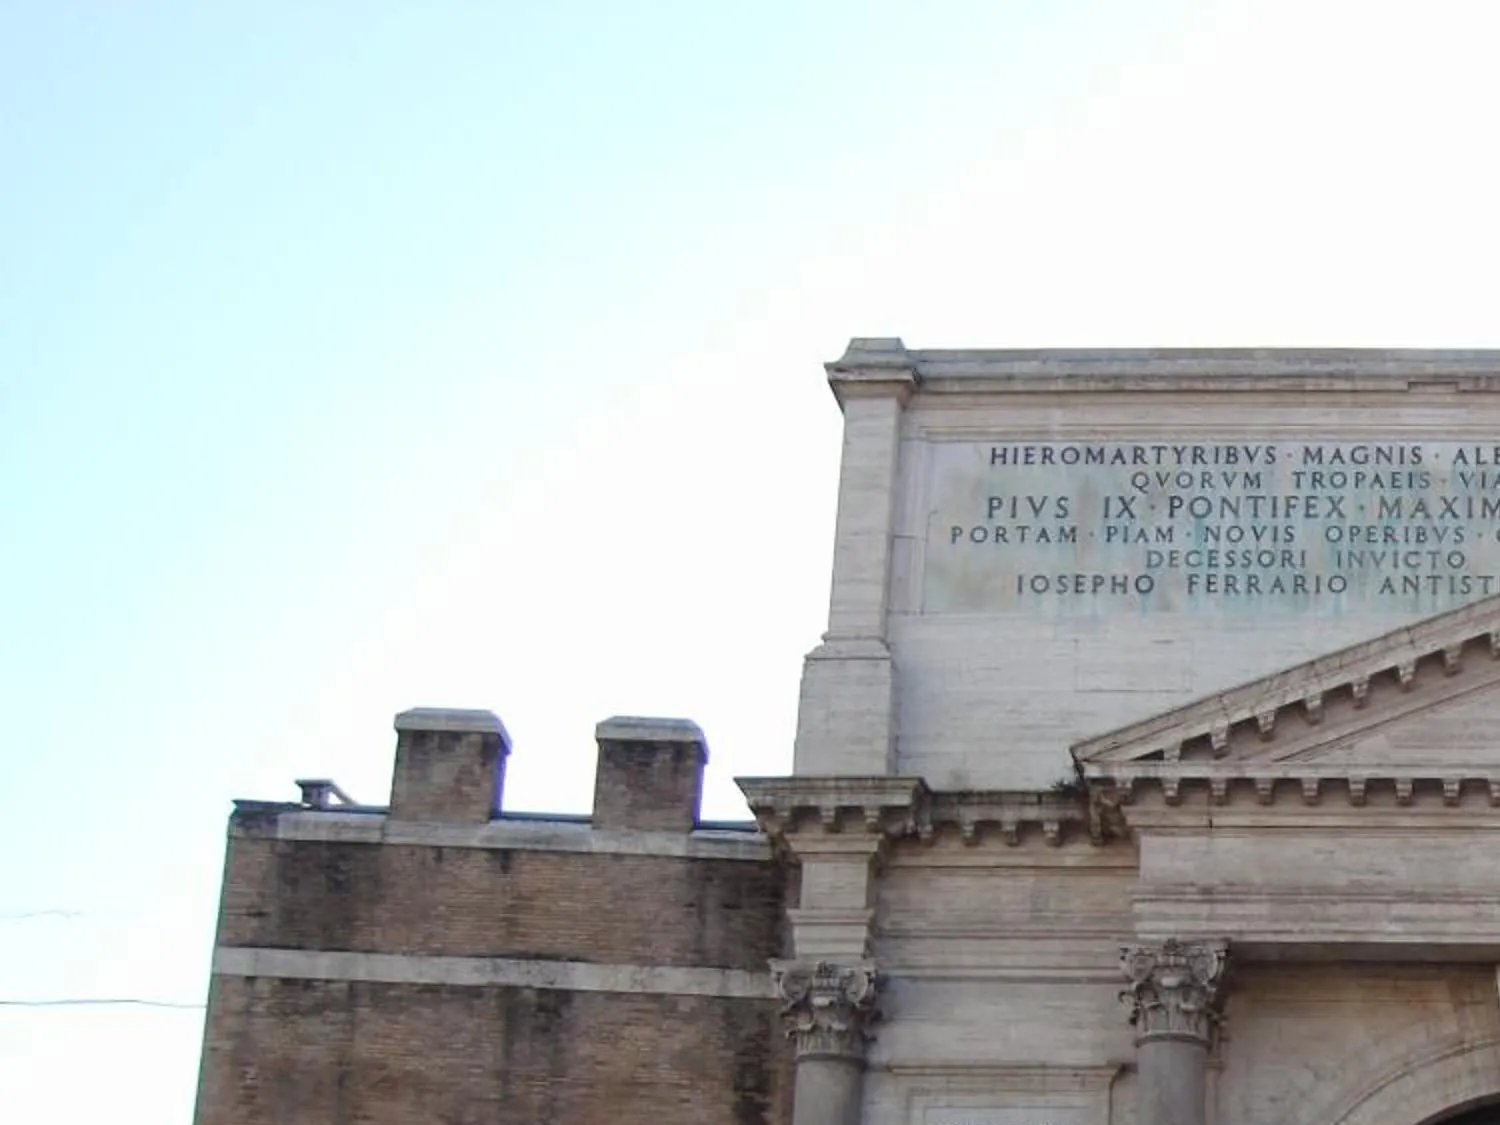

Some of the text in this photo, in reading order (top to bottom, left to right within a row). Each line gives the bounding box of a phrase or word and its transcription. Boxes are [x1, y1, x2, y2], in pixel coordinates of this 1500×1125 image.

[990, 446, 1277, 466] HIEROMARTYRIBVS
[1303, 446, 1423, 466] MAGNIS
[1131, 471, 1262, 493] QVORVM
[1292, 471, 1431, 489] TROPAEIS
[987, 495, 1070, 519] PIVS
[1104, 495, 1136, 519] IX
[1168, 495, 1346, 519] PONTIFEX
[951, 525, 1078, 544] PORTAM
[1105, 525, 1175, 544] PIAM
[1203, 525, 1295, 544] NOVIS
[1325, 525, 1466, 544] OPERIBVS
[1145, 550, 1306, 569] DECESSORI
[1337, 550, 1466, 569] INVICTO
[1017, 574, 1155, 595] IOSEPHO
[1187, 574, 1348, 595] FERRARIO
